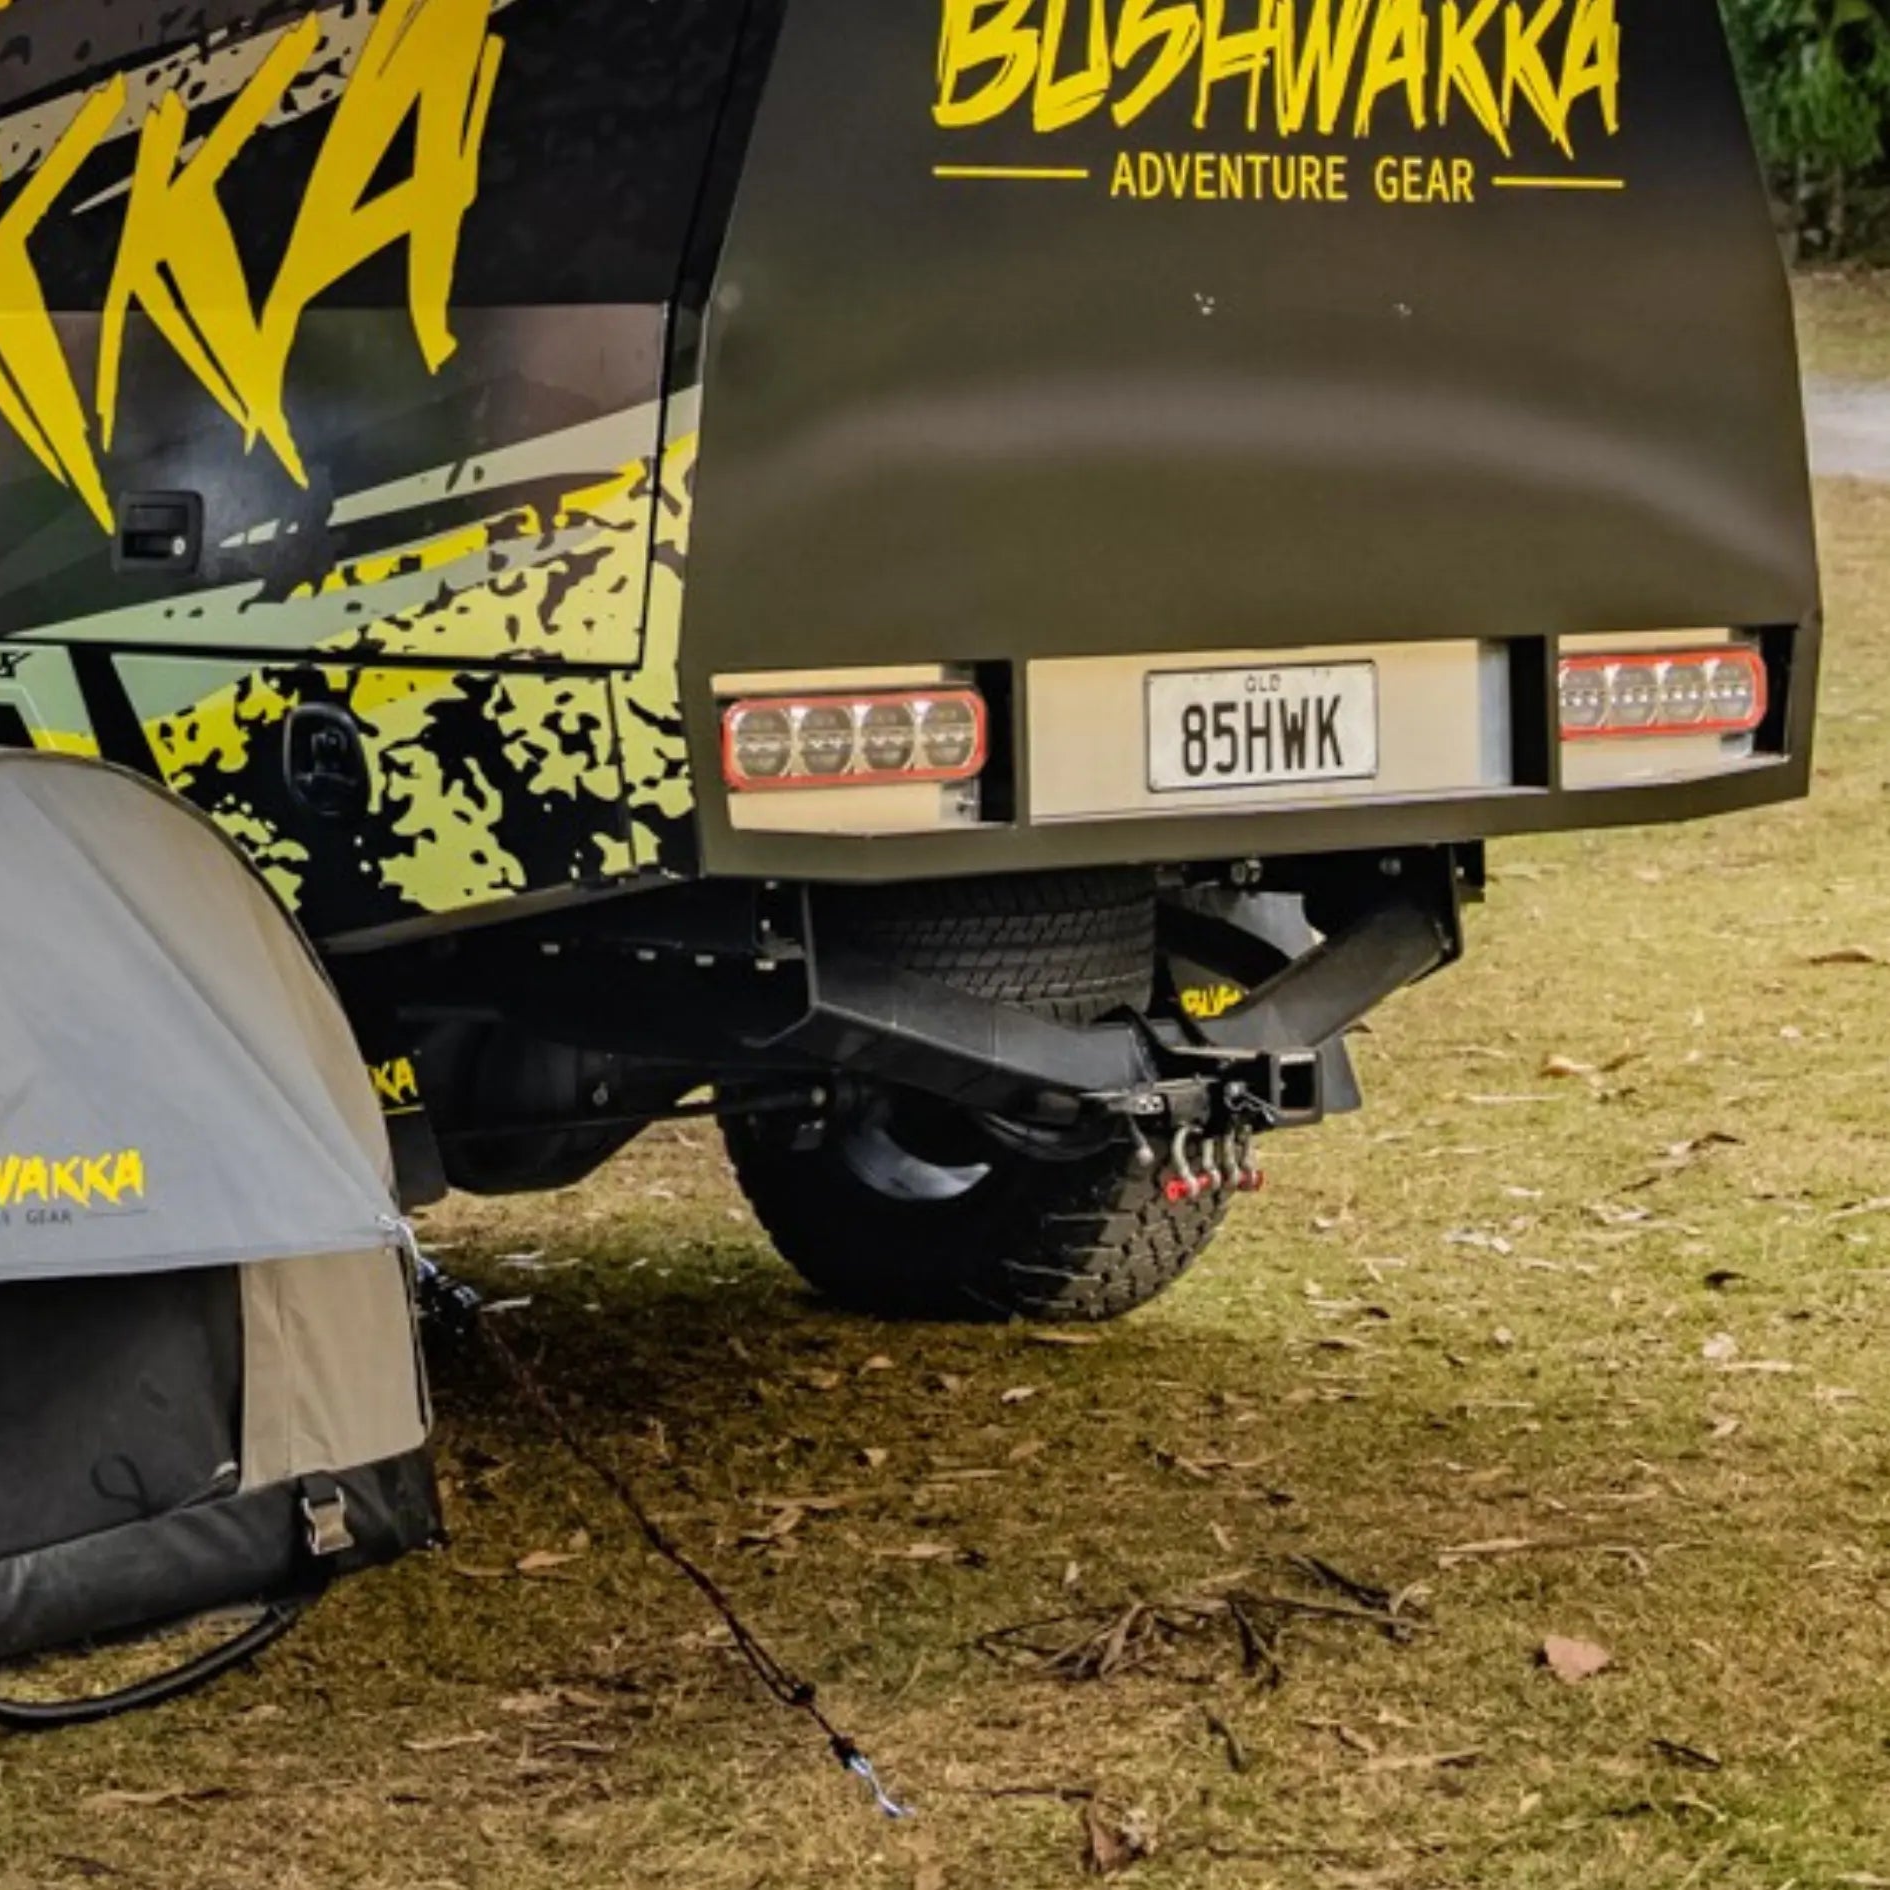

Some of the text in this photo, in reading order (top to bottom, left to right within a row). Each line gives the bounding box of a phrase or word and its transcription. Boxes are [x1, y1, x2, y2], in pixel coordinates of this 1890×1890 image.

[932, 0, 1619, 159] BUSHWAKKA
[1110, 151, 1475, 203] ADVENTURE GEAR
[1181, 695, 1343, 777] 85HWK
[25, 1209, 73, 1225] GEAR
